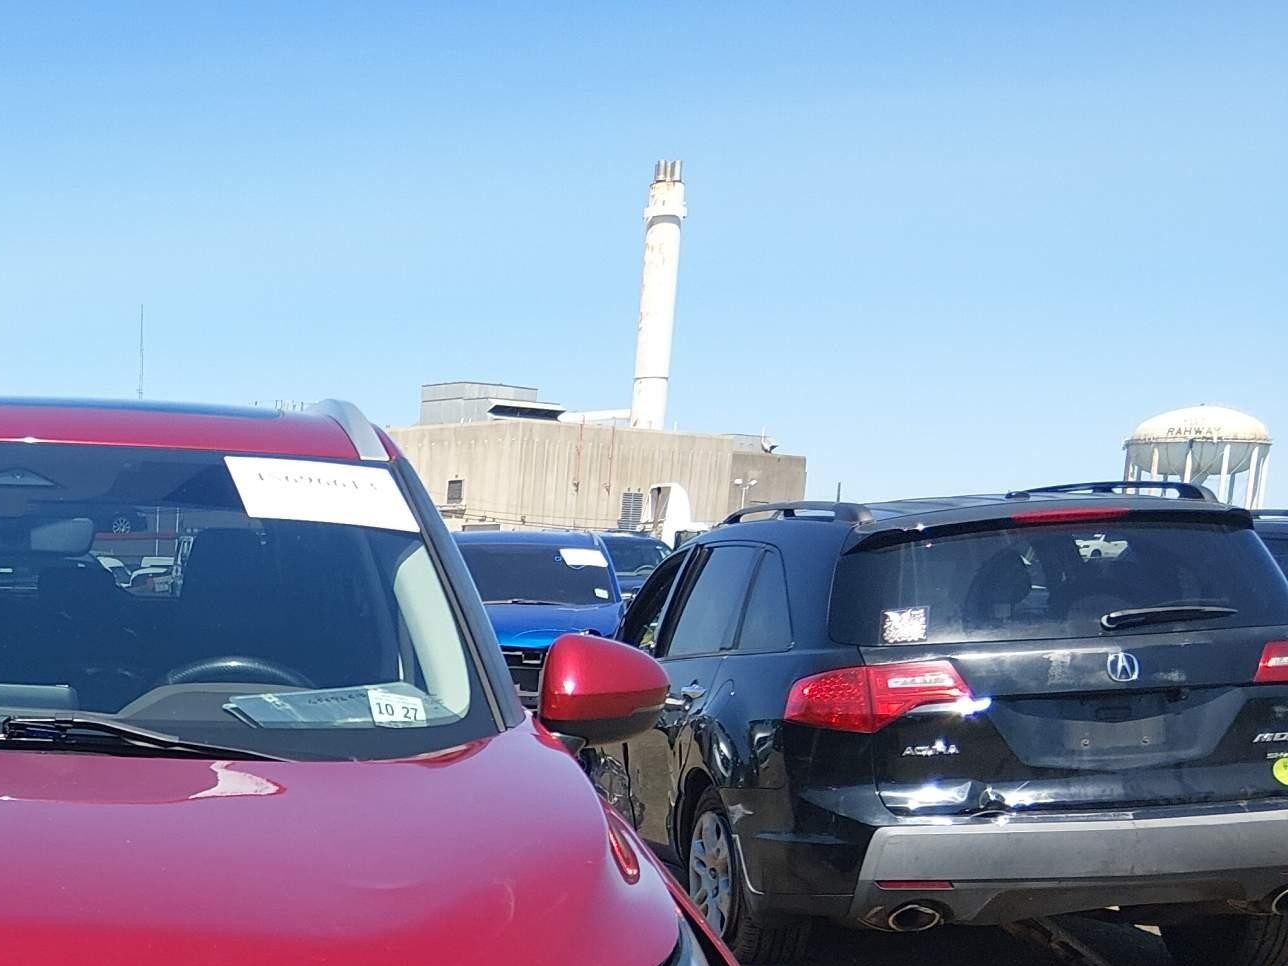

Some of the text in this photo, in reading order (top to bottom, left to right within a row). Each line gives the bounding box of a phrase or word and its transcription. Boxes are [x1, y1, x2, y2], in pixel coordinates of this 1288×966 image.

[1166, 426, 1222, 436] RAHWAY
[376, 702, 418, 721] 10 27
[901, 744, 960, 757] ACA
